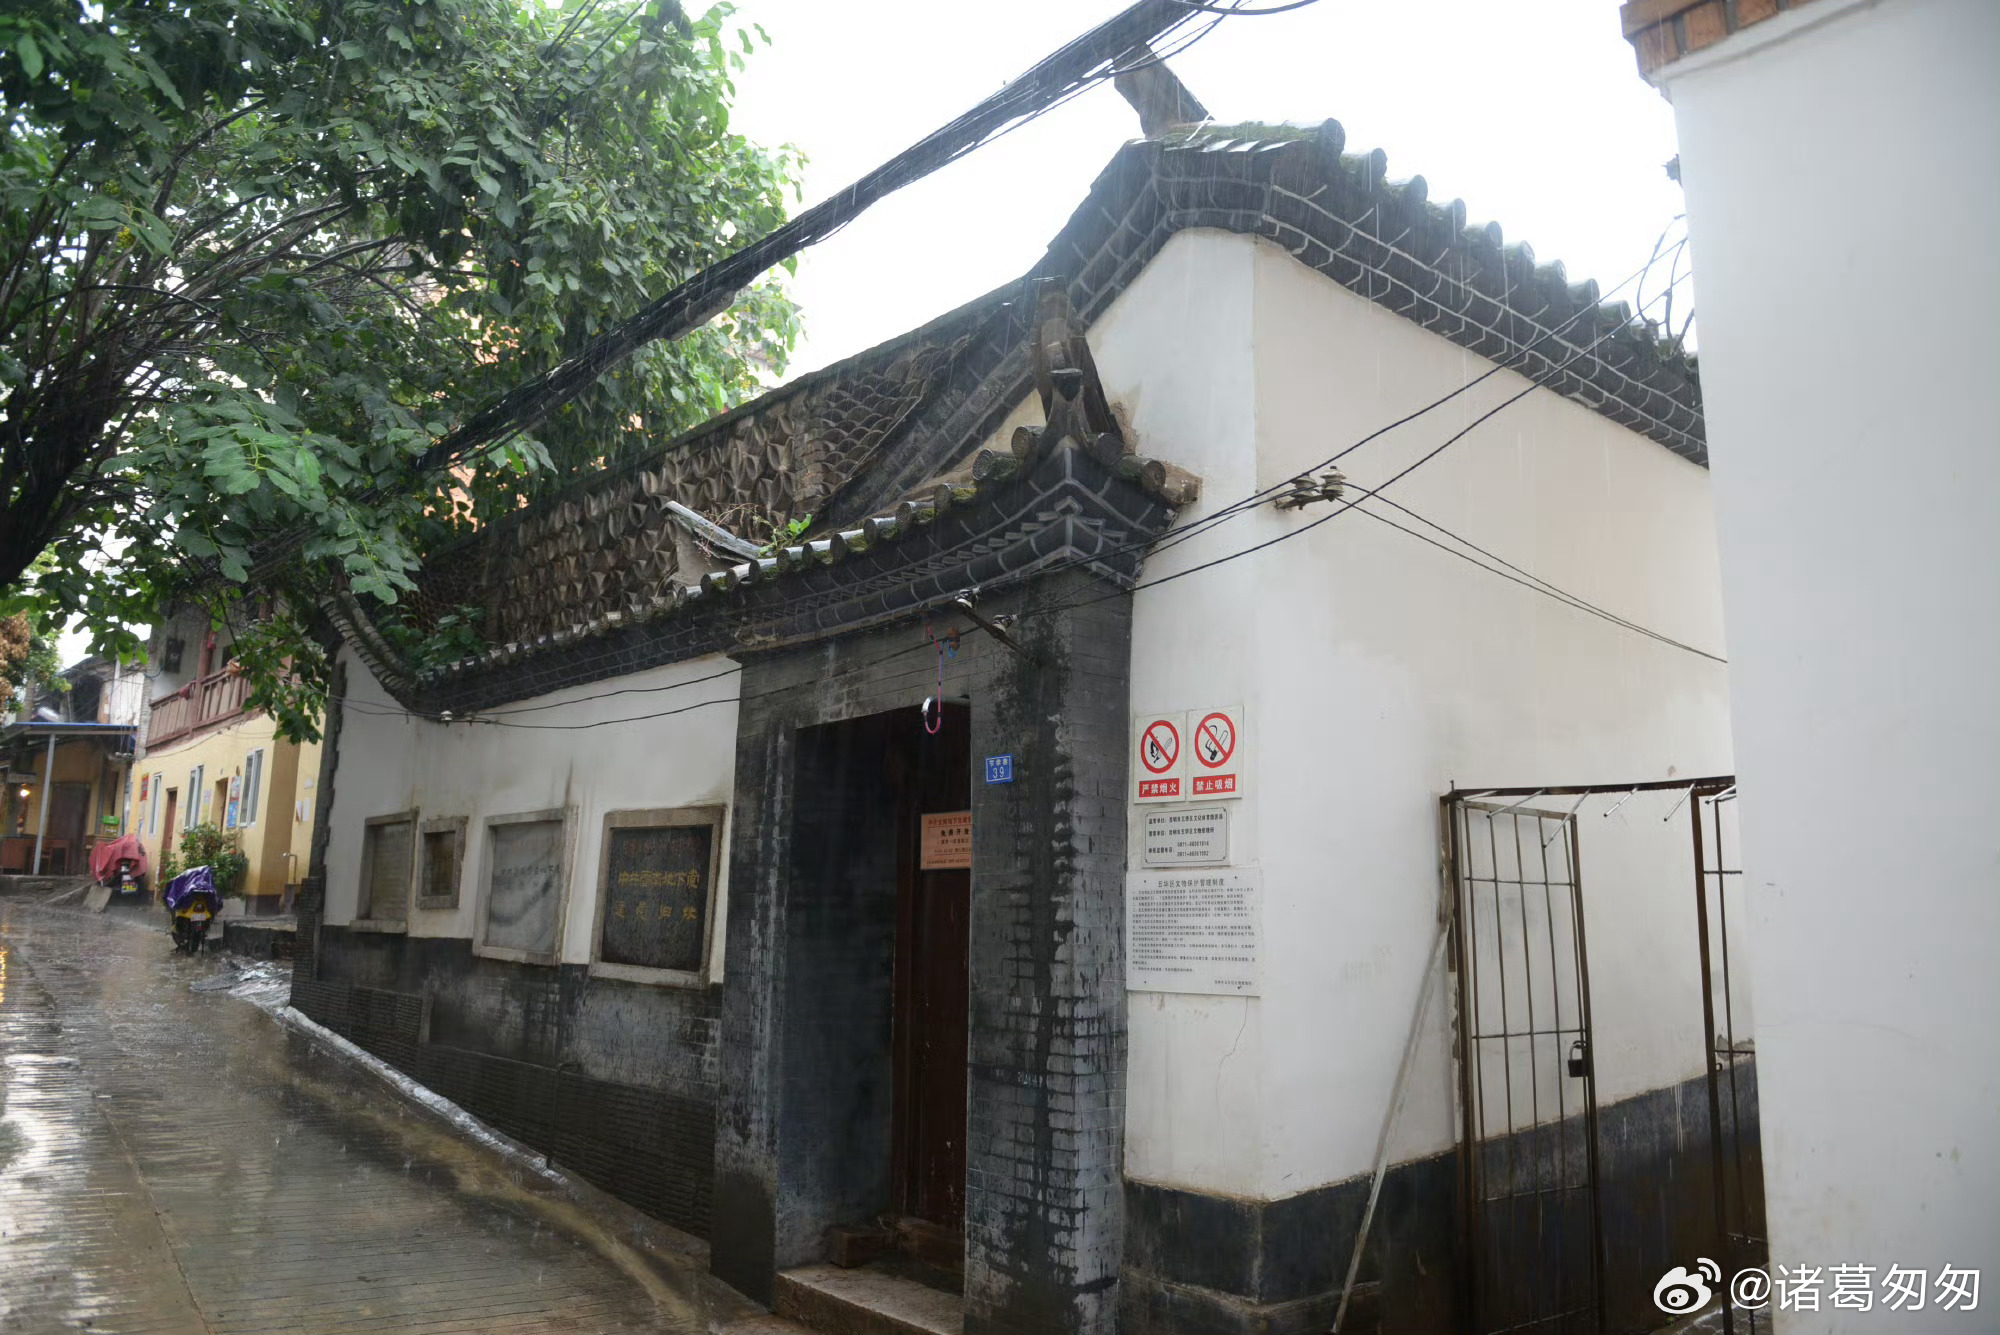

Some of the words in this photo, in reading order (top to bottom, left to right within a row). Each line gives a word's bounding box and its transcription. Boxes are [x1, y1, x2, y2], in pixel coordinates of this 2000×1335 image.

[993, 766, 1005, 779] 39
[1142, 782, 1177, 795] 严禁烟火
[1196, 778, 1233, 791] 禁止吸烟
[1158, 878, 1225, 888] 五华区文物保护管理制度
